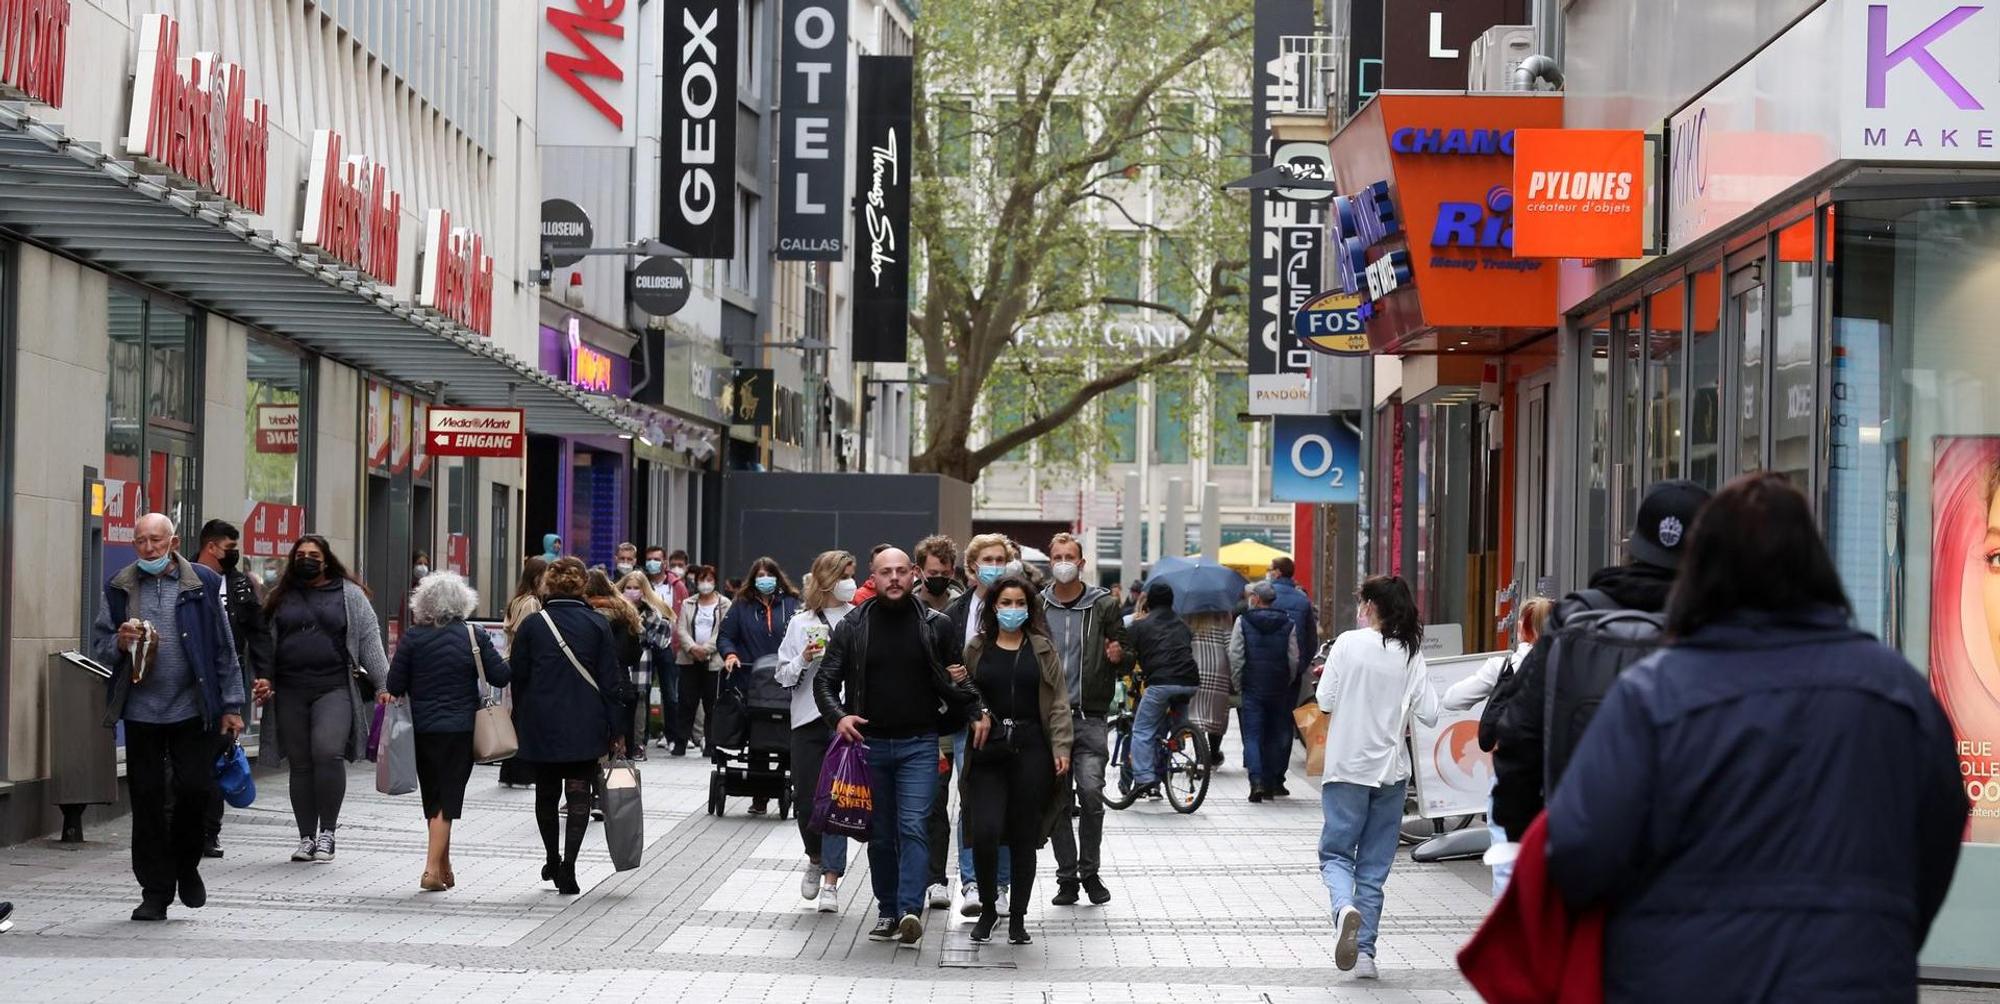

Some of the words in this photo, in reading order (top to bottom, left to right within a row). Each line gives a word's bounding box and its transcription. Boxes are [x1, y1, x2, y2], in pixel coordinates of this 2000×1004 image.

[1428, 12, 1459, 58] L
[1866, 4, 2000, 111] K
[679, 7, 718, 226] GEOX
[1864, 127, 1994, 148] MAKE
[867, 127, 898, 209] Thomas
[1671, 107, 1709, 213] KIKO
[1528, 171, 1633, 200] PYLONES
[1527, 202, 1577, 213] créateur
[1582, 201, 1632, 215] d'objets
[780, 237, 840, 252] CALLAS
[865, 203, 896, 287] Sabo
[635, 276, 683, 289] COLLOSEUM
[437, 416, 472, 428] Media
[479, 417, 511, 429] Markt
[455, 433, 513, 449] EINGANG
[1291, 433, 1344, 488] O2
[1963, 780, 2000, 802] OO
